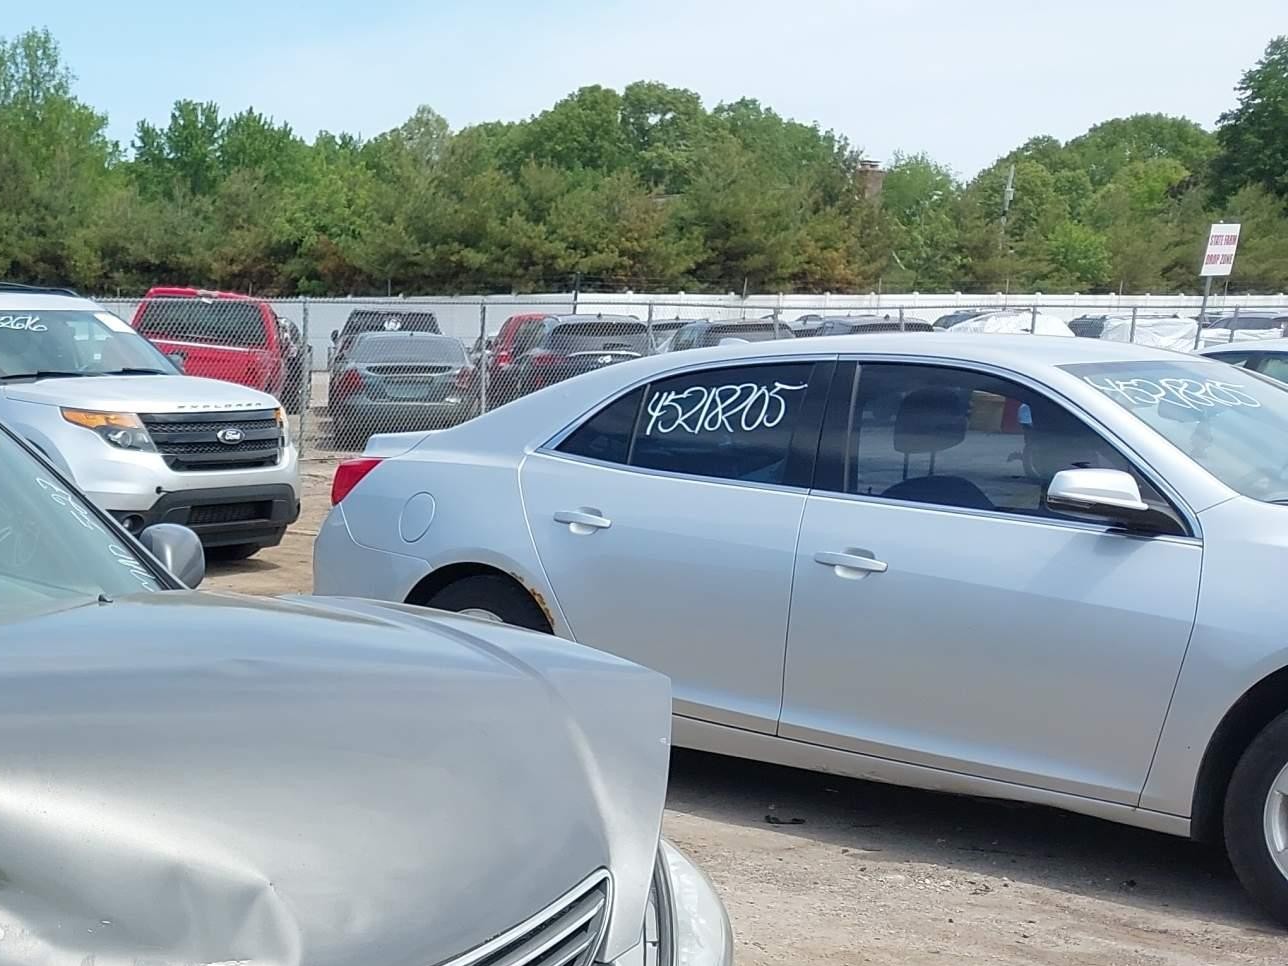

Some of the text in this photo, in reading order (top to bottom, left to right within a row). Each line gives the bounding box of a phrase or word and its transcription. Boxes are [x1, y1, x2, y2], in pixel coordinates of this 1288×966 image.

[1210, 234, 1238, 246] STATE FARM
[1205, 253, 1233, 265] DROP ZONE
[646, 381, 809, 436] 45218205
